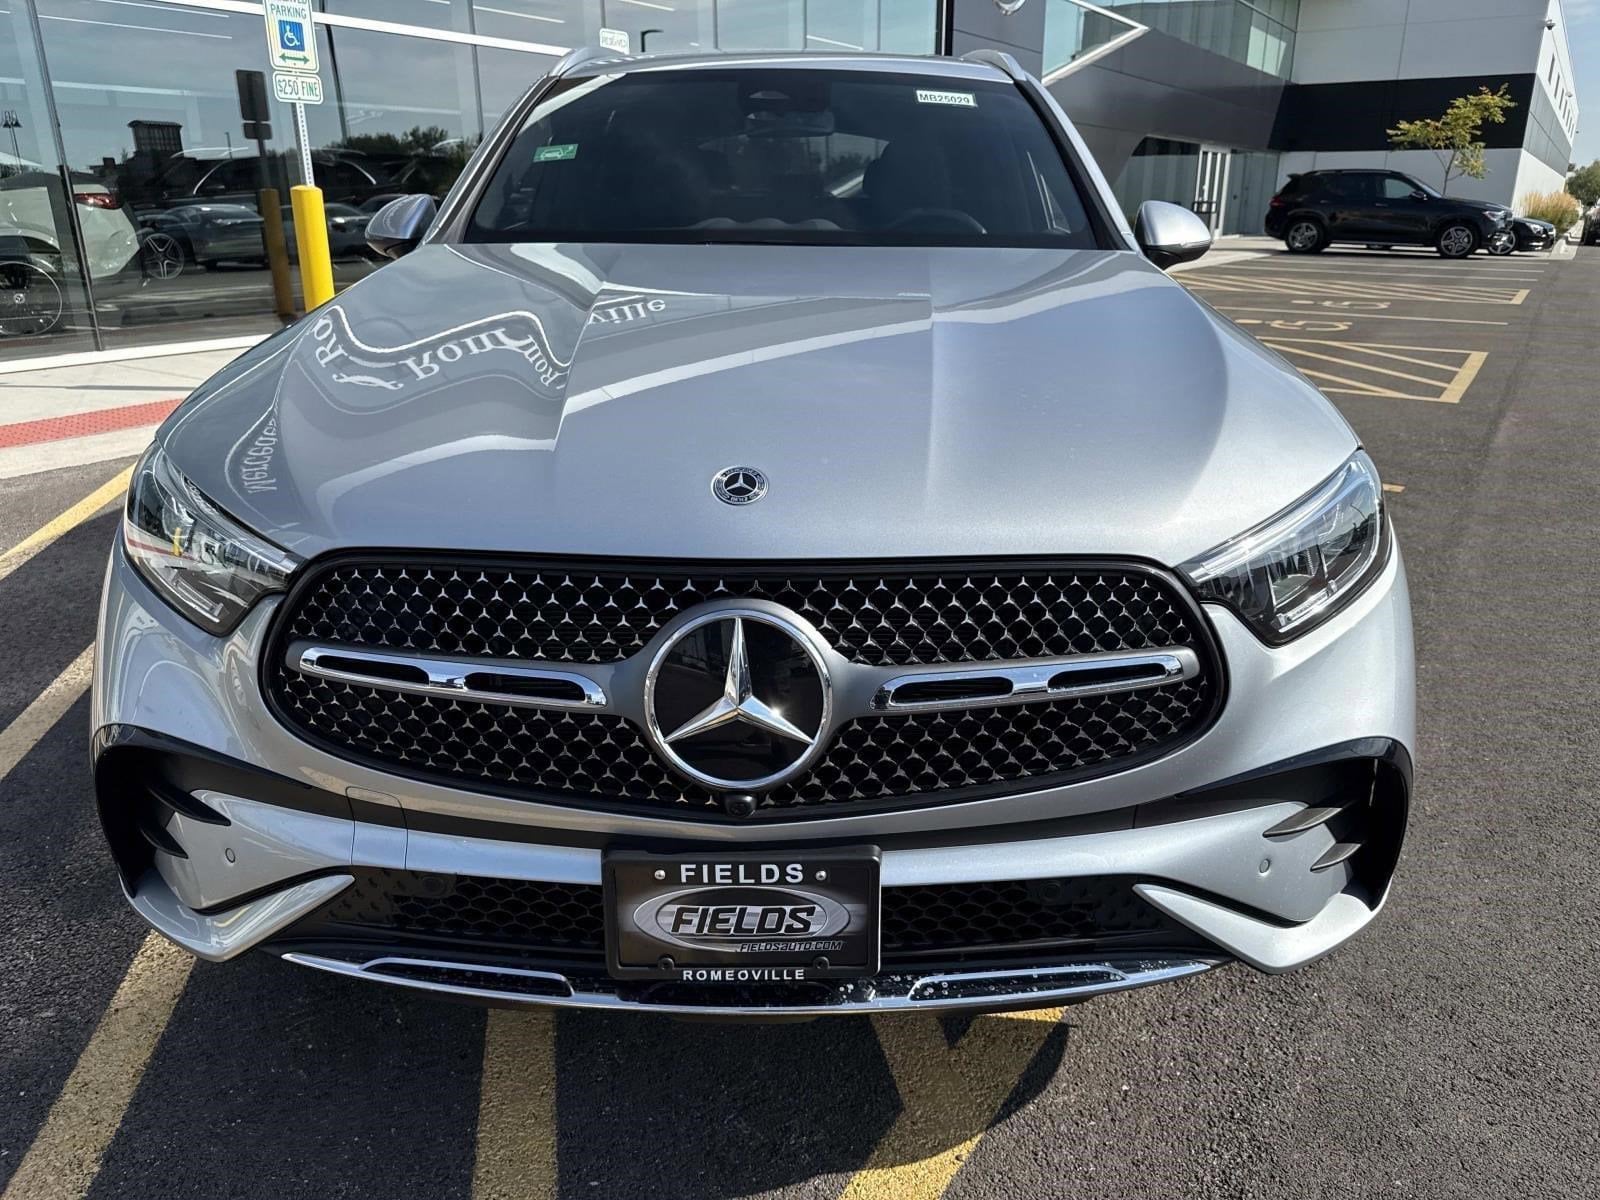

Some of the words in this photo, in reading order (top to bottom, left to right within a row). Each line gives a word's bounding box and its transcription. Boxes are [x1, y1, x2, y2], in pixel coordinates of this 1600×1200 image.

[270, 3, 307, 19] PARKING
[277, 79, 299, 96] $250
[301, 81, 319, 97] FINE
[680, 863, 804, 884] FIELDS
[671, 905, 816, 935] FIELDS
[683, 968, 805, 981] ROMEOVILLE
